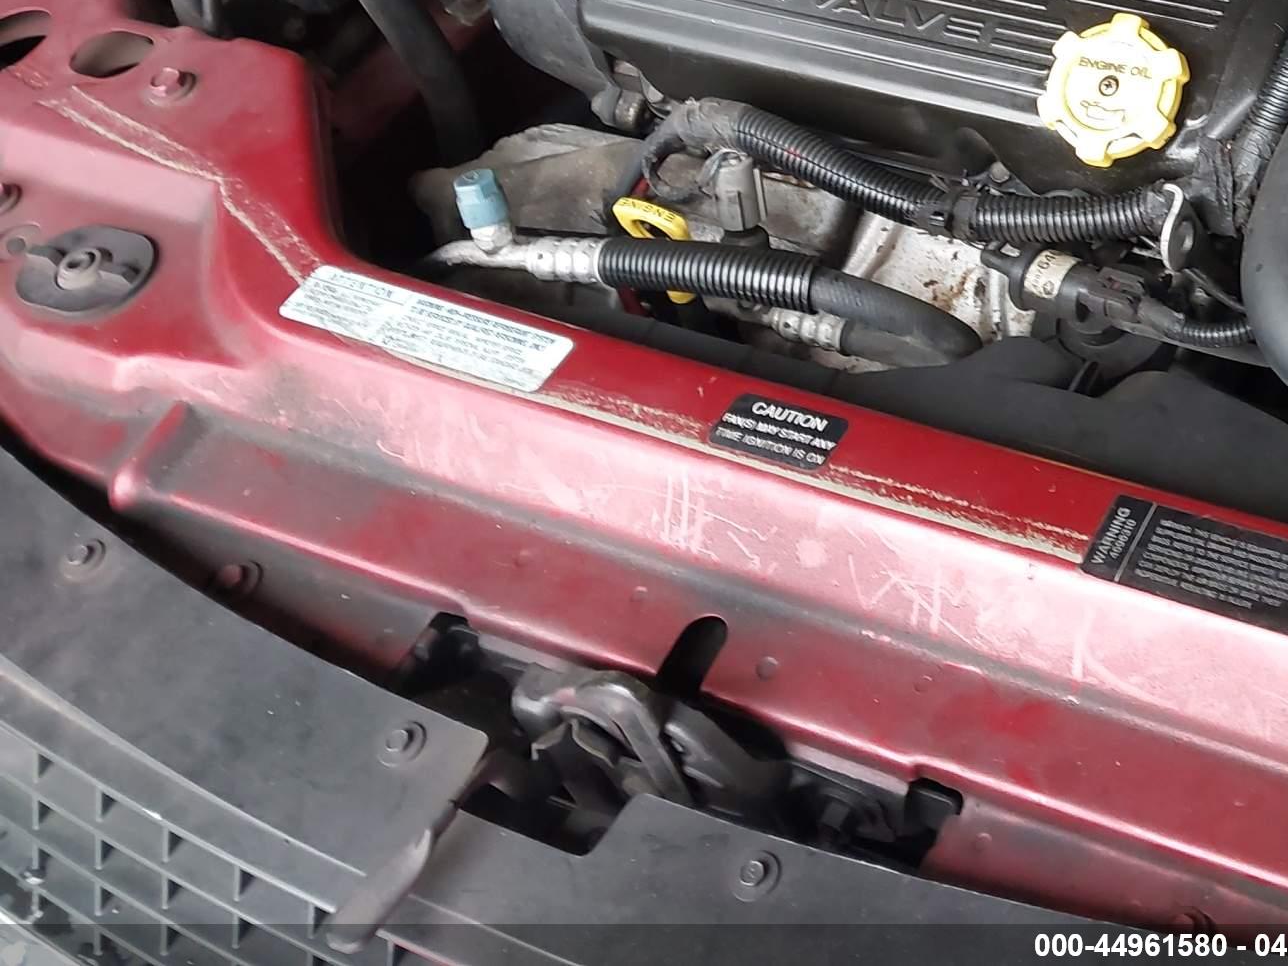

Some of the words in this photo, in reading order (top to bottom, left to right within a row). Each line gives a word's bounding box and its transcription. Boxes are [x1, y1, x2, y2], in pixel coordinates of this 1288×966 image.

[1078, 56, 1127, 74] ENGINE
[1130, 66, 1153, 80] OIL
[751, 401, 829, 432] CAUTION
[715, 426, 744, 443] TIME
[741, 434, 793, 455] IGNITION
[792, 448, 806, 460] IS
[806, 452, 826, 465] ON
[778, 428, 814, 445] START
[810, 438, 838, 451] ANY
[1091, 506, 1132, 564] WARNING
